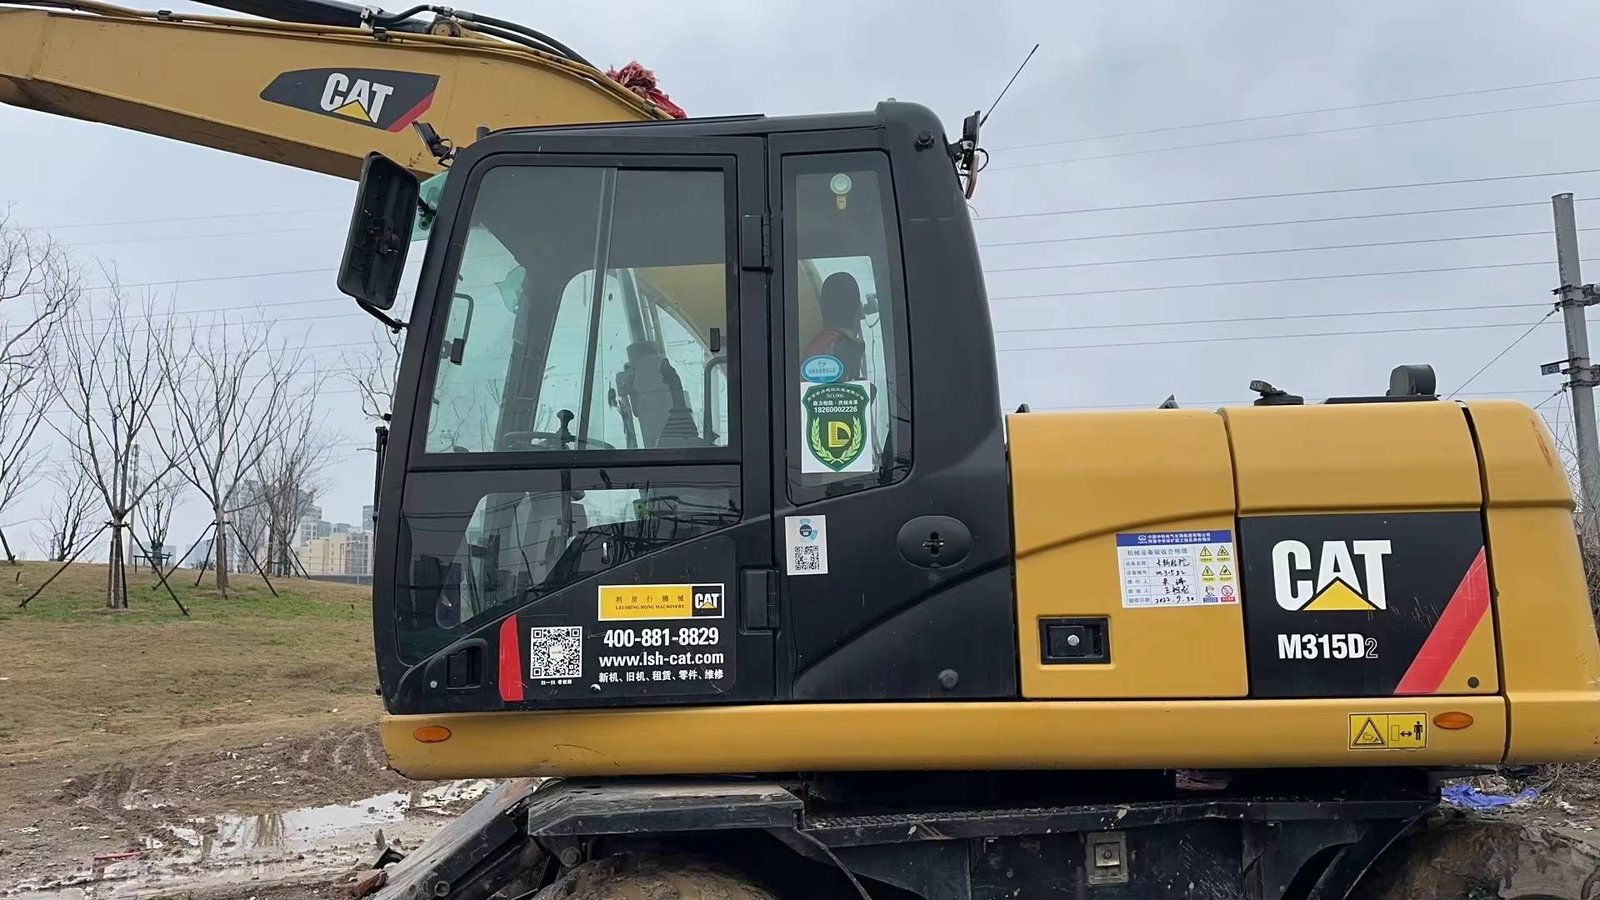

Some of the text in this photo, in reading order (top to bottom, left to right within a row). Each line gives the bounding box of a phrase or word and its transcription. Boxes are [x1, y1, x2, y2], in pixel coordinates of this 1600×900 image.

[320, 72, 394, 123] CAT
[1272, 540, 1392, 611] CAT
[694, 593, 721, 609] CAT
[603, 627, 719, 648] 400-881-8829
[598, 651, 724, 667] www.lsh-cat.com
[598, 669, 724, 683] 新机、旧机、租赁、零件、维修
